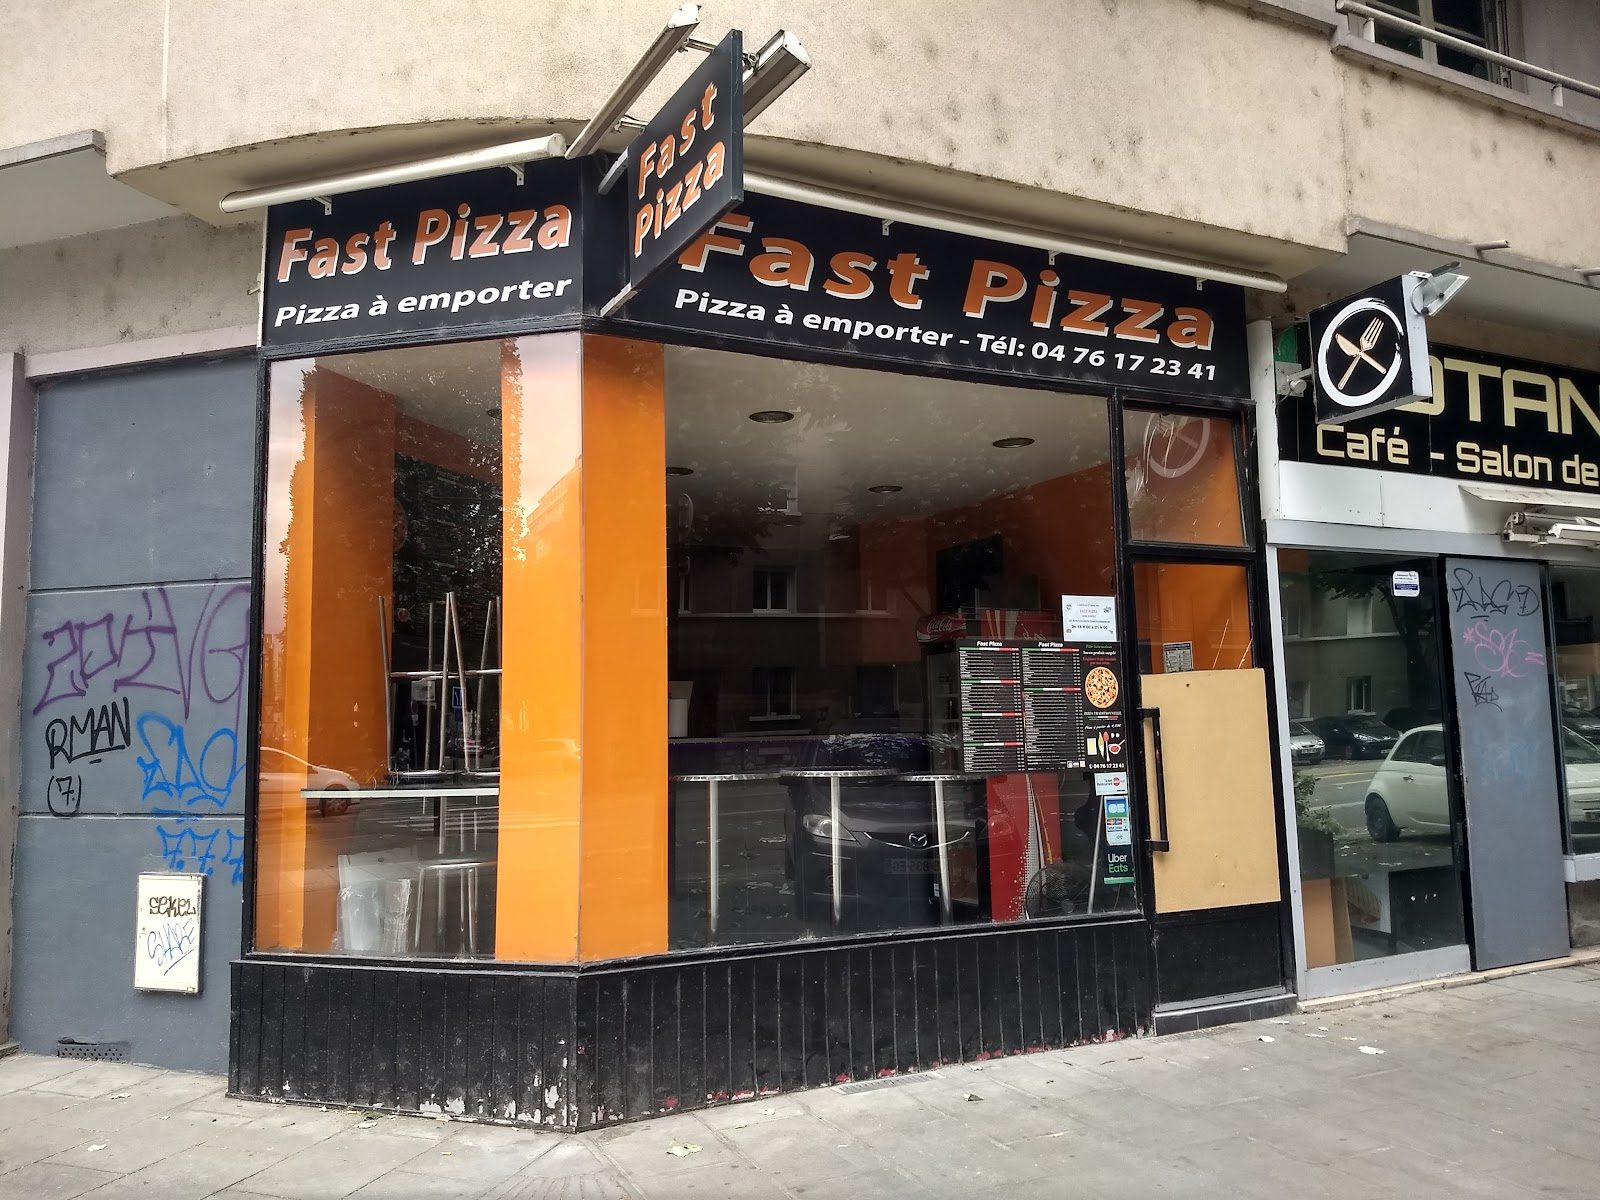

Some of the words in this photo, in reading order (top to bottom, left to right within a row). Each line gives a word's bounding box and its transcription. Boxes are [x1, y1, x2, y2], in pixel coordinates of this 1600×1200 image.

[637, 82, 718, 200] Fast
[634, 138, 726, 257] Pizza
[277, 219, 397, 282] Fast
[411, 202, 574, 265] Pizza
[677, 211, 931, 309] Fast
[962, 258, 1216, 351] Pizza
[274, 303, 359, 327] Pizza
[368, 294, 387, 316] à
[397, 276, 572, 314] emporter
[674, 288, 765, 321] Pizza
[774, 302, 794, 325] à
[801, 311, 949, 348] emporter
[976, 332, 1025, 357] Tél:
[1031, 342, 1065, 362] 04
[1072, 346, 1105, 368] 76
[1115, 351, 1143, 372] 17
[1150, 356, 1181, 376] 23
[1187, 361, 1217, 381] 41
[1316, 424, 1409, 465] Café
[1456, 441, 1552, 482] Salon
[1562, 455, 1599, 487] de
[1107, 853, 1128, 863] Uber
[1108, 863, 1128, 873] Eats
